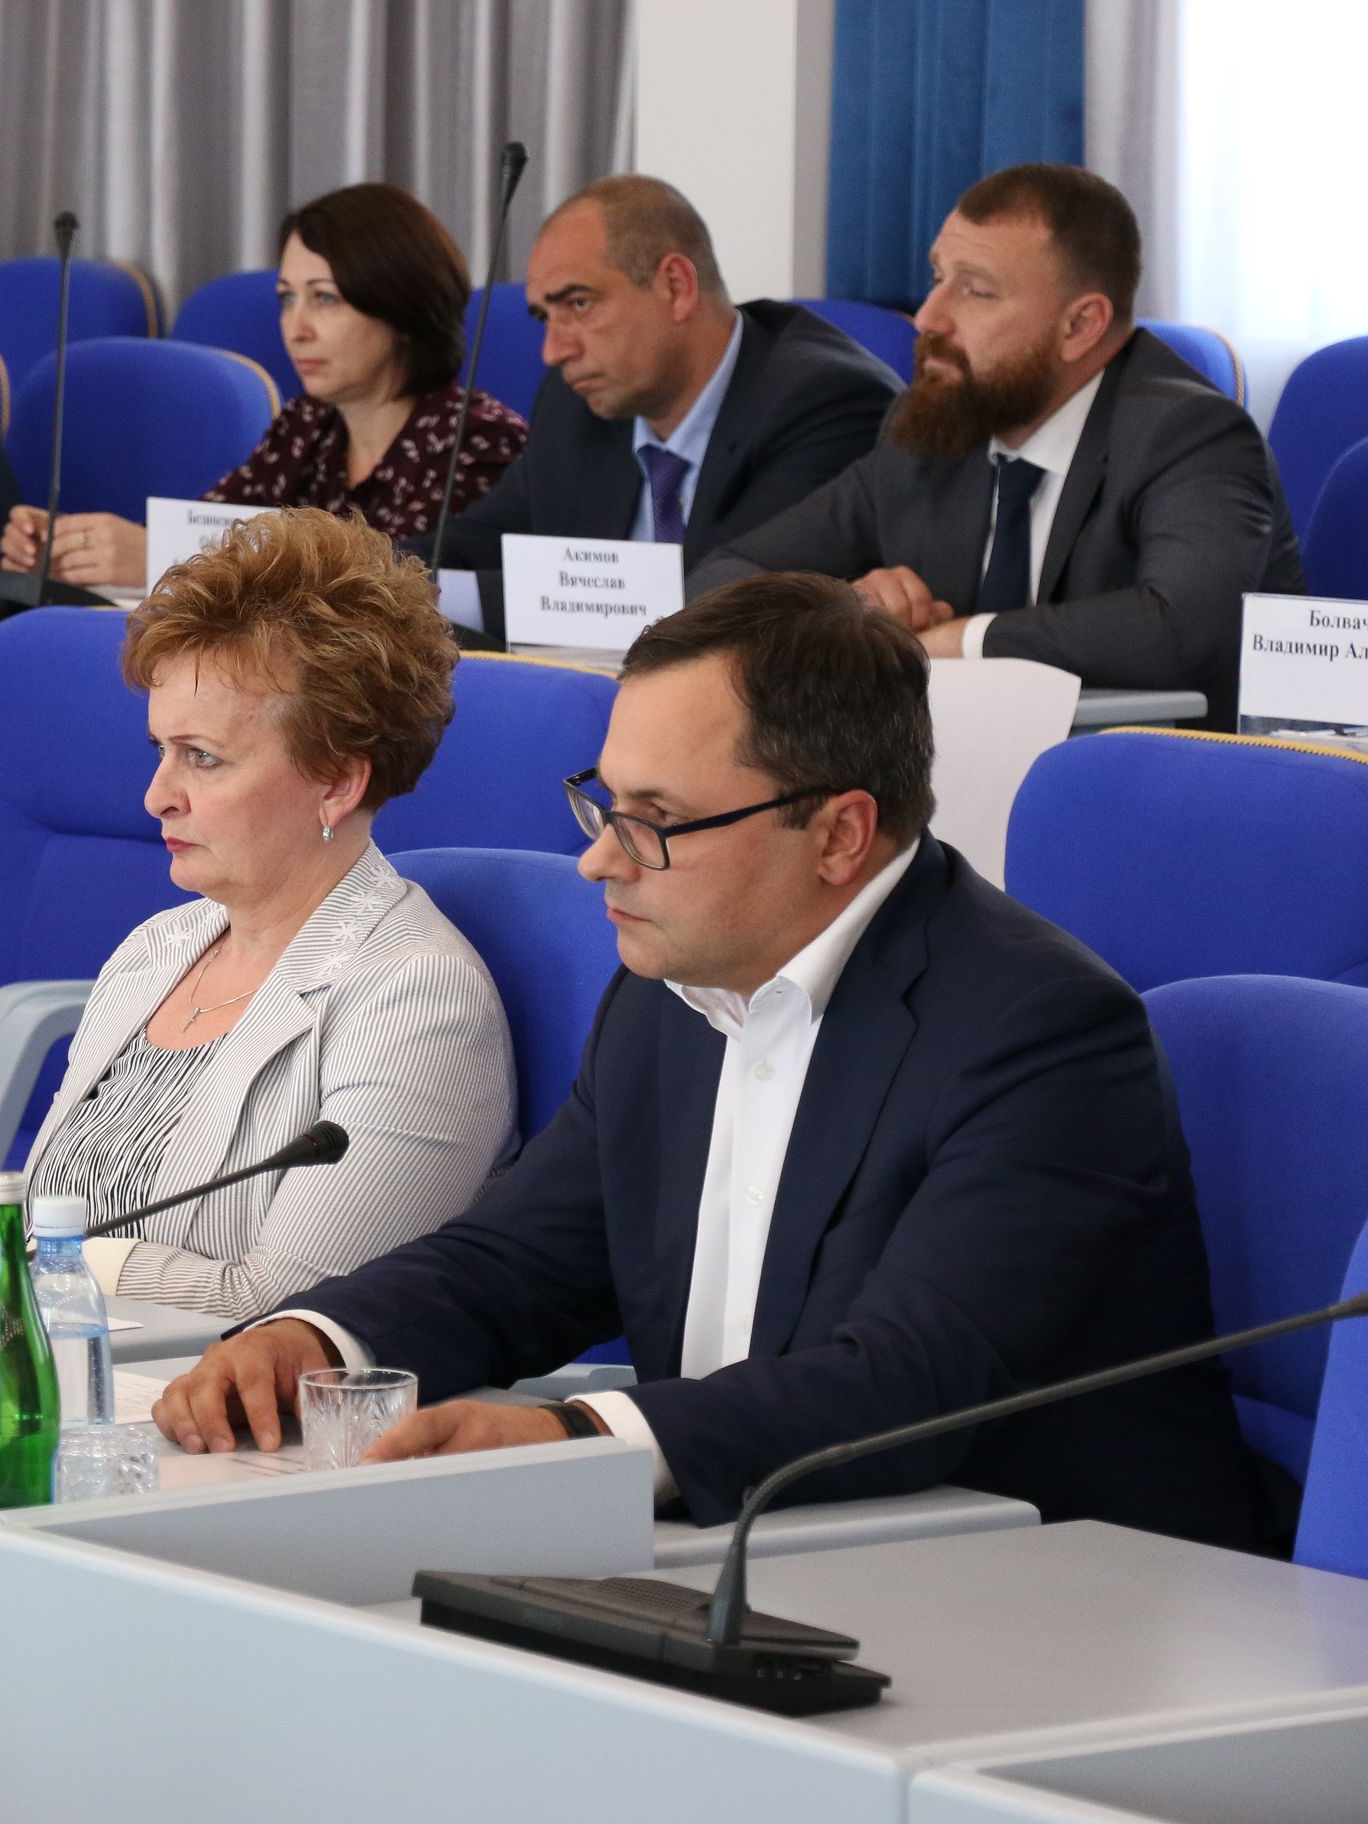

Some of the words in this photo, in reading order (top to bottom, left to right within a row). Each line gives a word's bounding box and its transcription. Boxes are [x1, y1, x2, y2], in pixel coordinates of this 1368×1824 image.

[564, 547, 620, 564] Акимов
[559, 571, 626, 590] Вячеслав
[540, 595, 648, 619] Владимирович
[1252, 633, 1340, 663] Владимир
